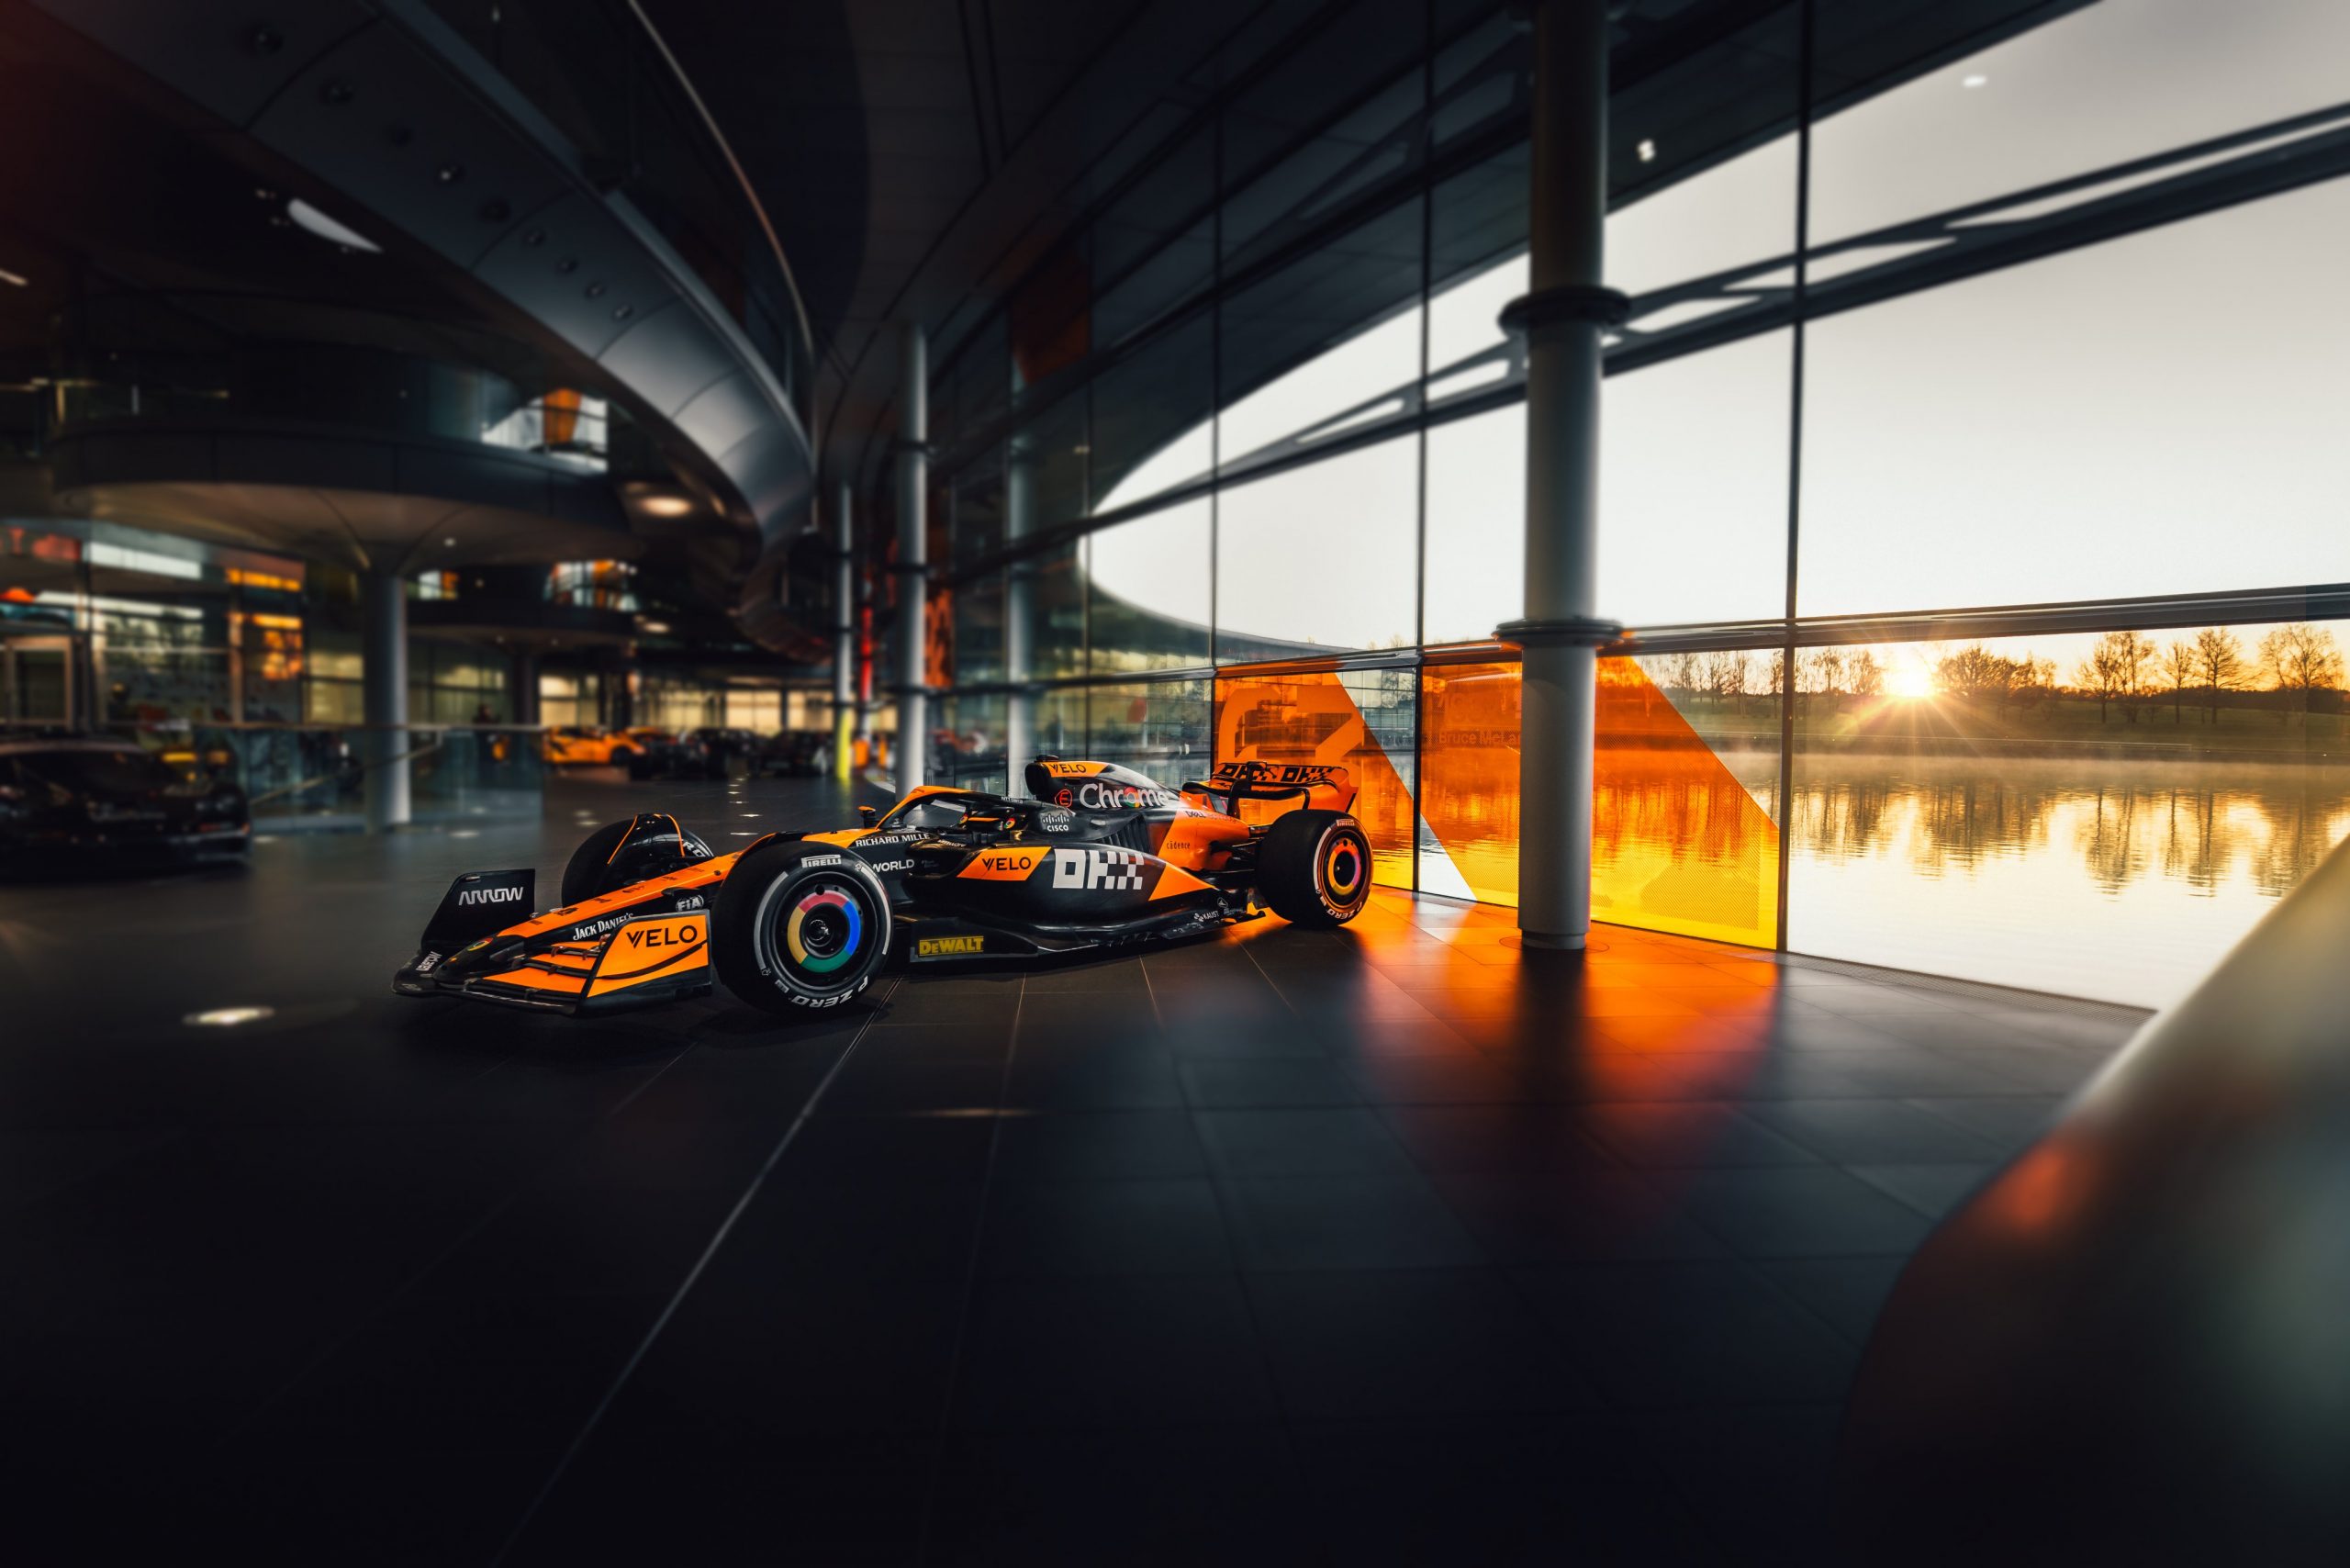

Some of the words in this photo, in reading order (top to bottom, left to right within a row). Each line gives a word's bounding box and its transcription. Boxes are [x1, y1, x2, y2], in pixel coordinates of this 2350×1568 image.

[1049, 764, 1087, 774] VELO
[1079, 783, 1169, 809] Chrome
[856, 835, 899, 847] RICHARD
[901, 833, 931, 843] MILLE
[801, 854, 842, 868] PIRELLI
[982, 857, 1032, 871] VELO
[1053, 848, 1145, 890] OKX
[459, 887, 524, 905] ARROW
[626, 924, 698, 948] VELO
[857, 975, 869, 993] P
[790, 991, 853, 1008] ZERO
